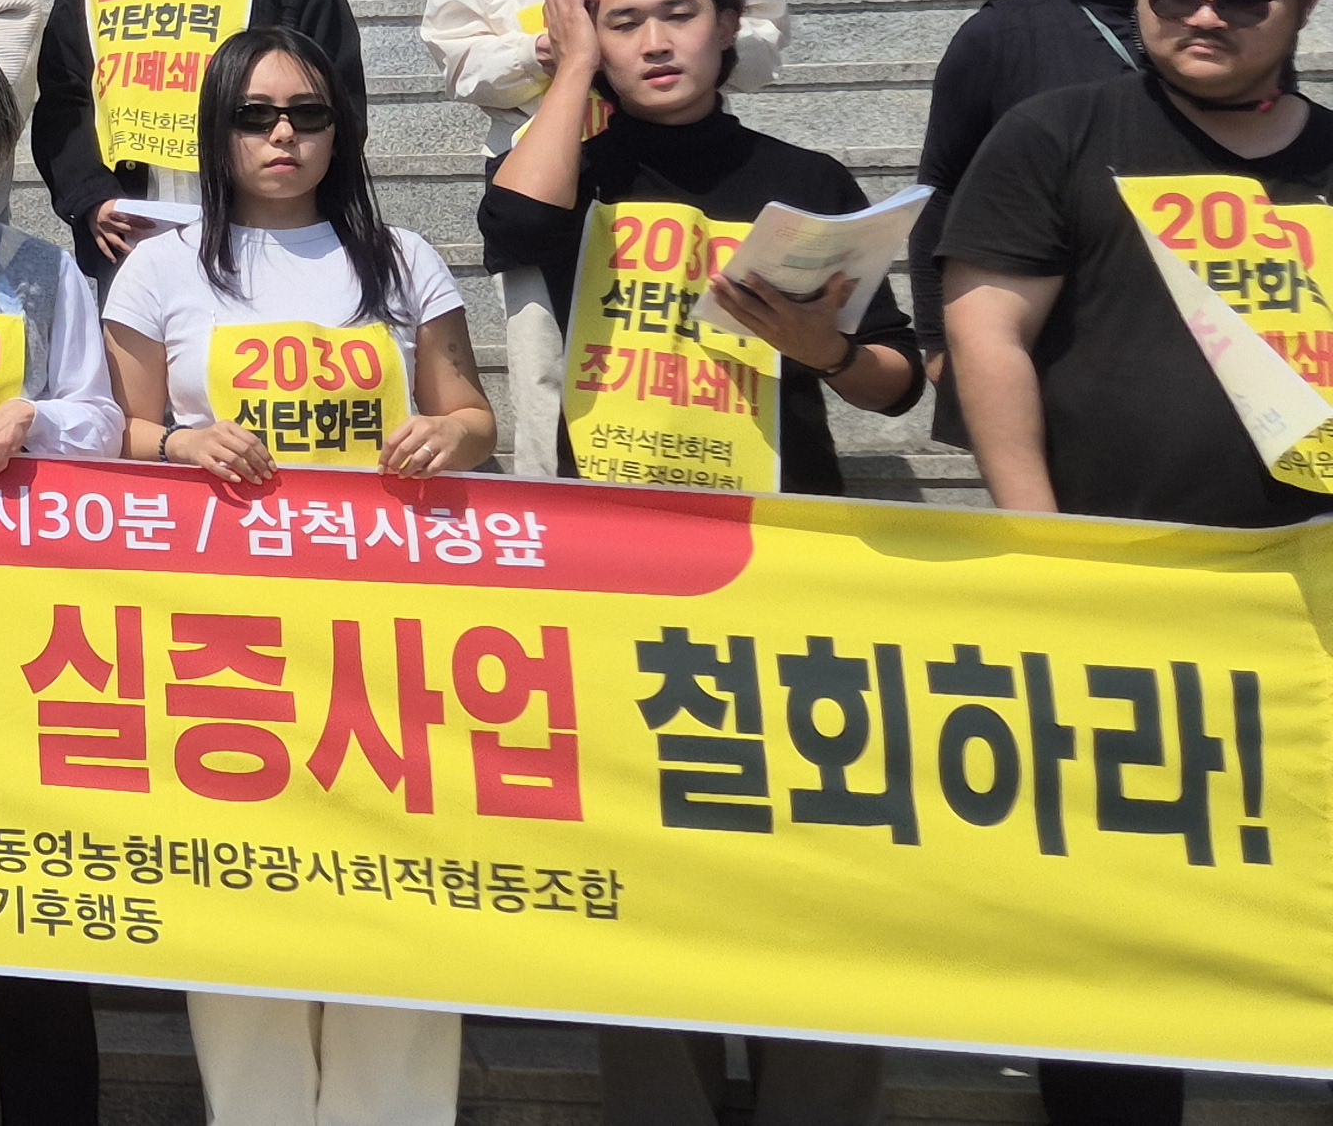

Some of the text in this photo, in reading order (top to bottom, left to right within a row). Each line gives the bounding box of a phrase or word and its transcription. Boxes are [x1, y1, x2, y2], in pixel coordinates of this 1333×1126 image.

[98, 2, 221, 43] 석탄화력
[233, 335, 383, 392] 2030
[575, 343, 759, 417] 조기폐쇄!!
[234, 397, 383, 452] 석탄화력
[590, 424, 733, 467] 삼척석탄화력
[195, 495, 218, 554] /
[239, 497, 547, 568] 삼척시청앞
[20, 603, 585, 823] 실증사업
[634, 625, 1273, 868] 철회하라!
